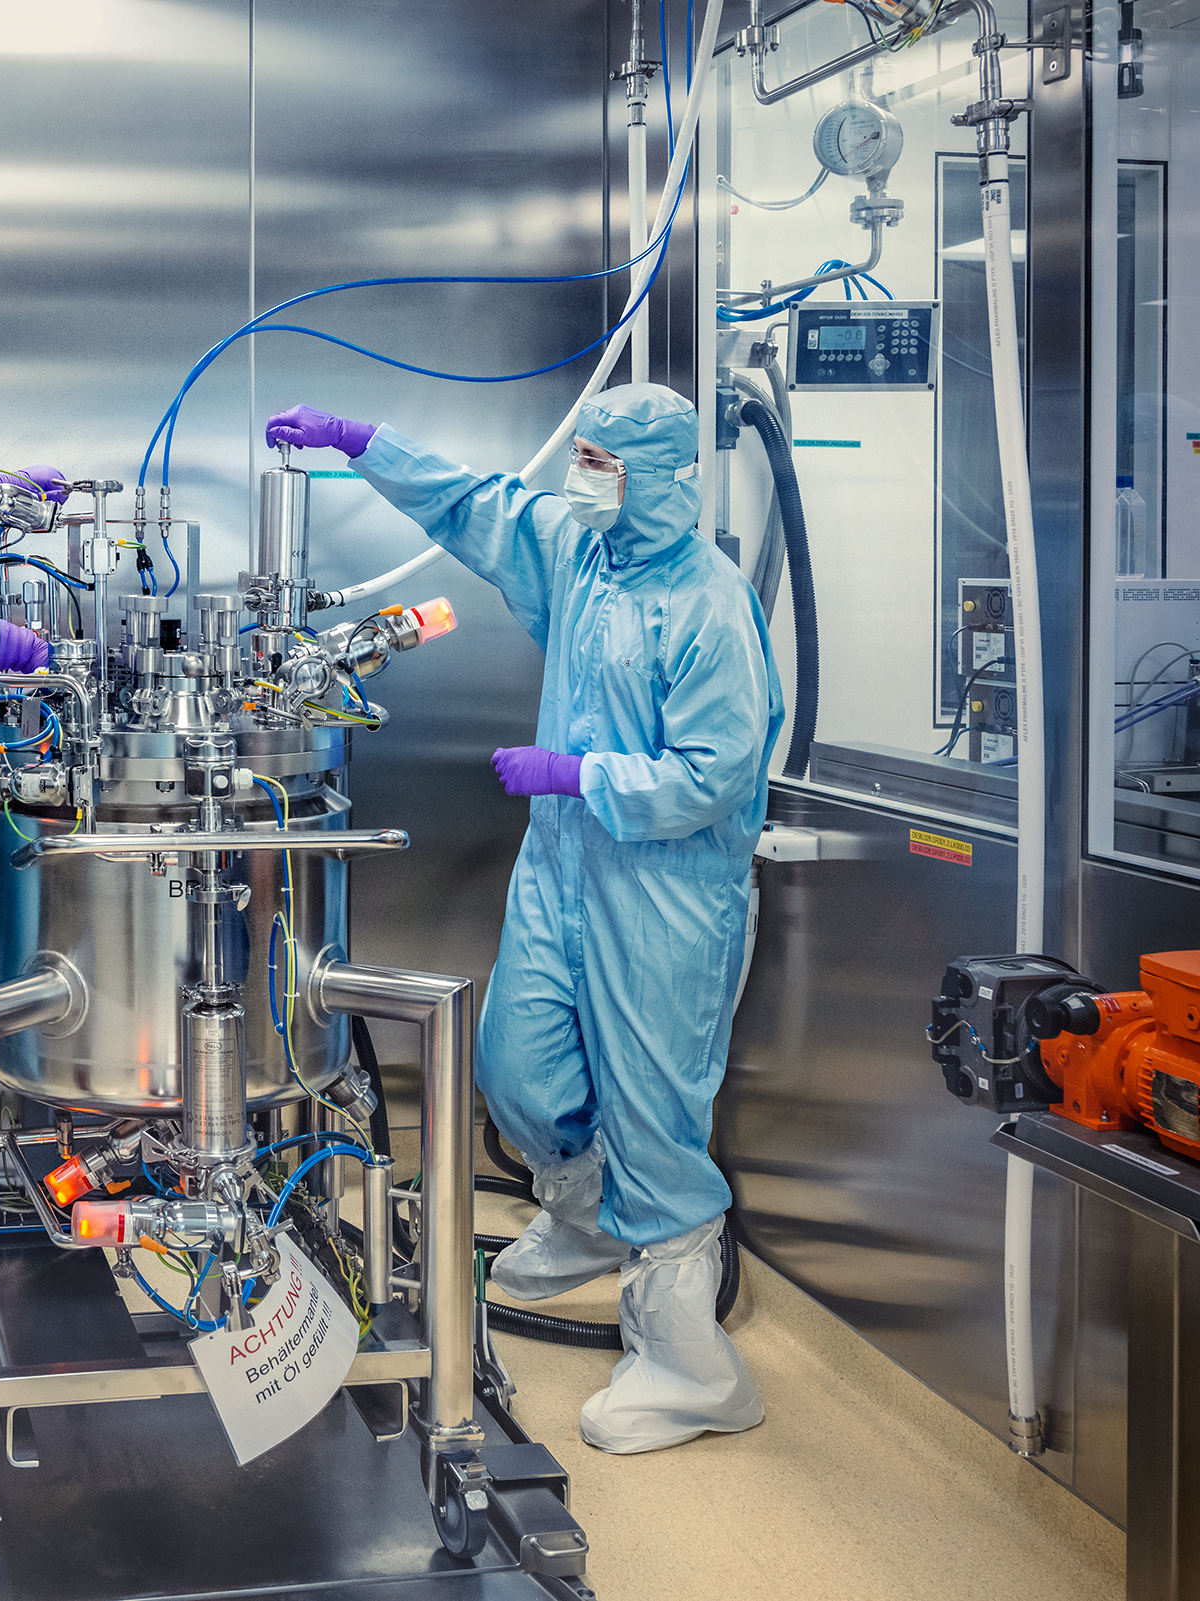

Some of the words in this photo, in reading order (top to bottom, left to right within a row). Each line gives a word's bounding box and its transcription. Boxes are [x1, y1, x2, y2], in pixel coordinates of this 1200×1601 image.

[245, 1282, 320, 1384] Behältermantel
[255, 1379, 282, 1404] mit
[283, 1360, 301, 1382] Öl
[302, 1317, 329, 1368] gefüllt
[323, 1301, 333, 1321] !!!
